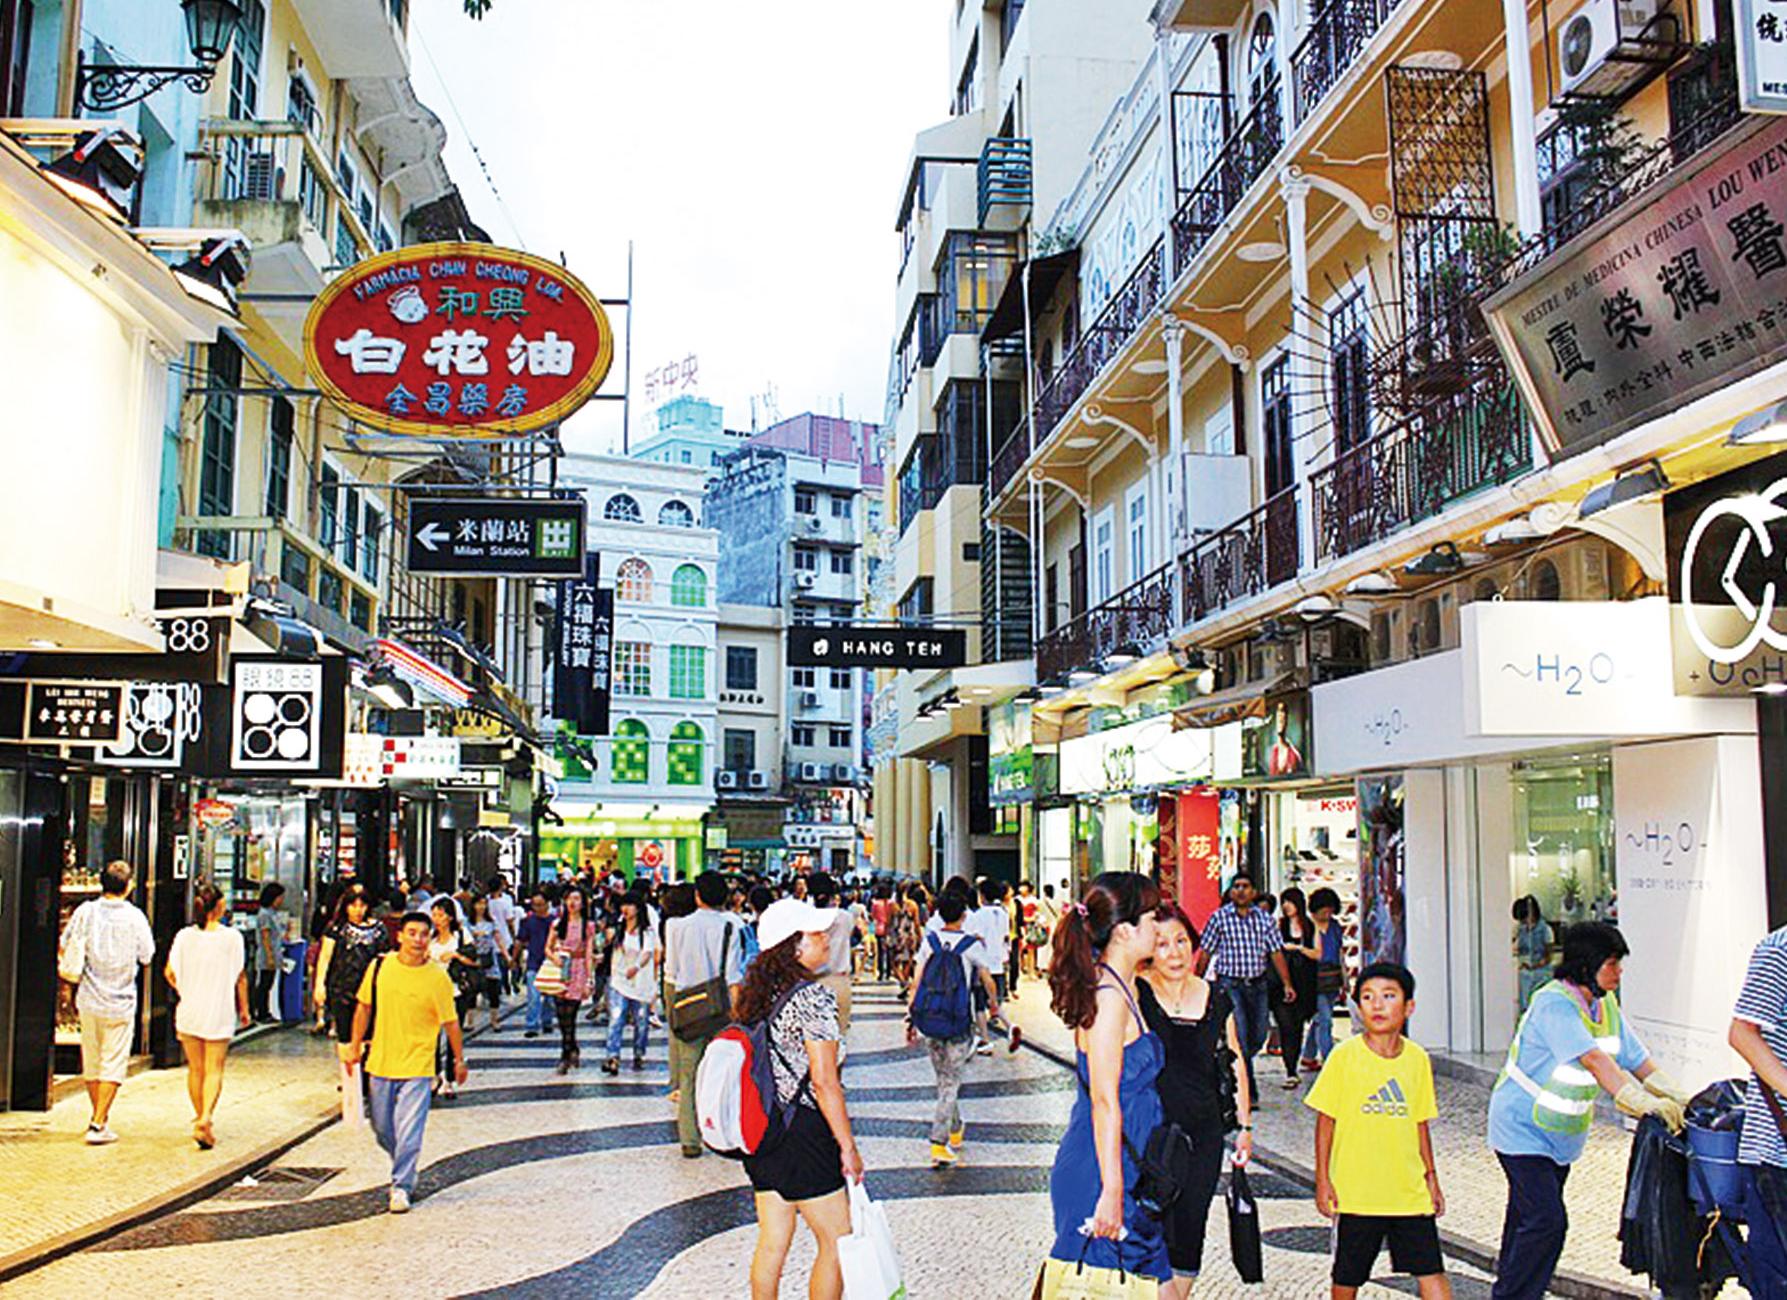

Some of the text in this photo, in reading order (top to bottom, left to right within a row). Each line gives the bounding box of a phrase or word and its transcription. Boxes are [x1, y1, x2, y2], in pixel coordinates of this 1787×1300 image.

[1521, 293, 1562, 327] MESTRE
[1564, 281, 1580, 301] DE
[1583, 243, 1643, 287] MEDICINA
[1645, 204, 1704, 251] CHINESA
[1708, 169, 1744, 210] LOU
[475, 260, 530, 286] CHEONG
[436, 286, 530, 322] 和興
[334, 328, 576, 377] 白花油
[455, 518, 531, 544] 米蘭站
[453, 545, 485, 557] Milan
[489, 545, 531, 557] Station
[572, 582, 595, 668] 六福珠寶
[842, 640, 943, 656] HANG TEN
